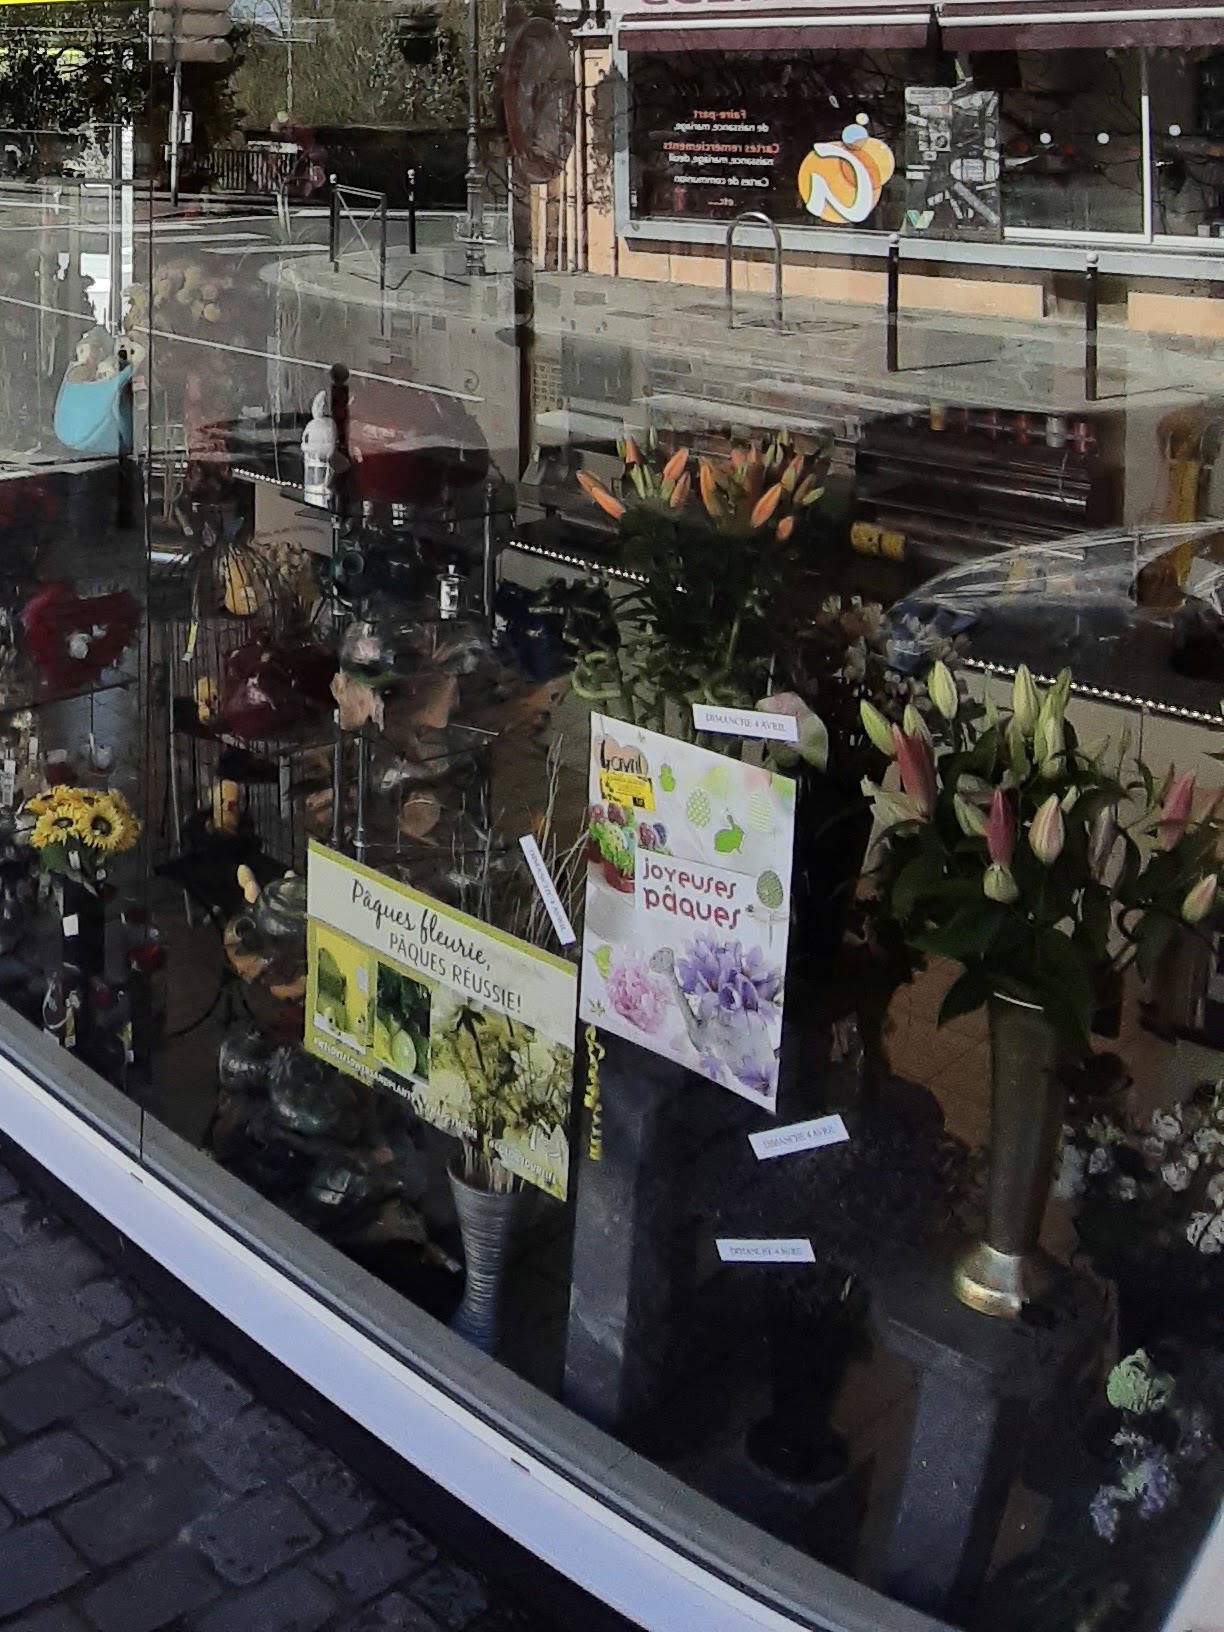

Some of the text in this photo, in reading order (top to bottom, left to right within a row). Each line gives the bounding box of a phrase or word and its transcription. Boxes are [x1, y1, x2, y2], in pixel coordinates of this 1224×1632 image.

[643, 856, 737, 900] joyeuses
[643, 886, 742, 931] pâques
[351, 877, 492, 973] Pâques fleurie,
[389, 930, 523, 1014] PÂQUES RÉUSSIE!
